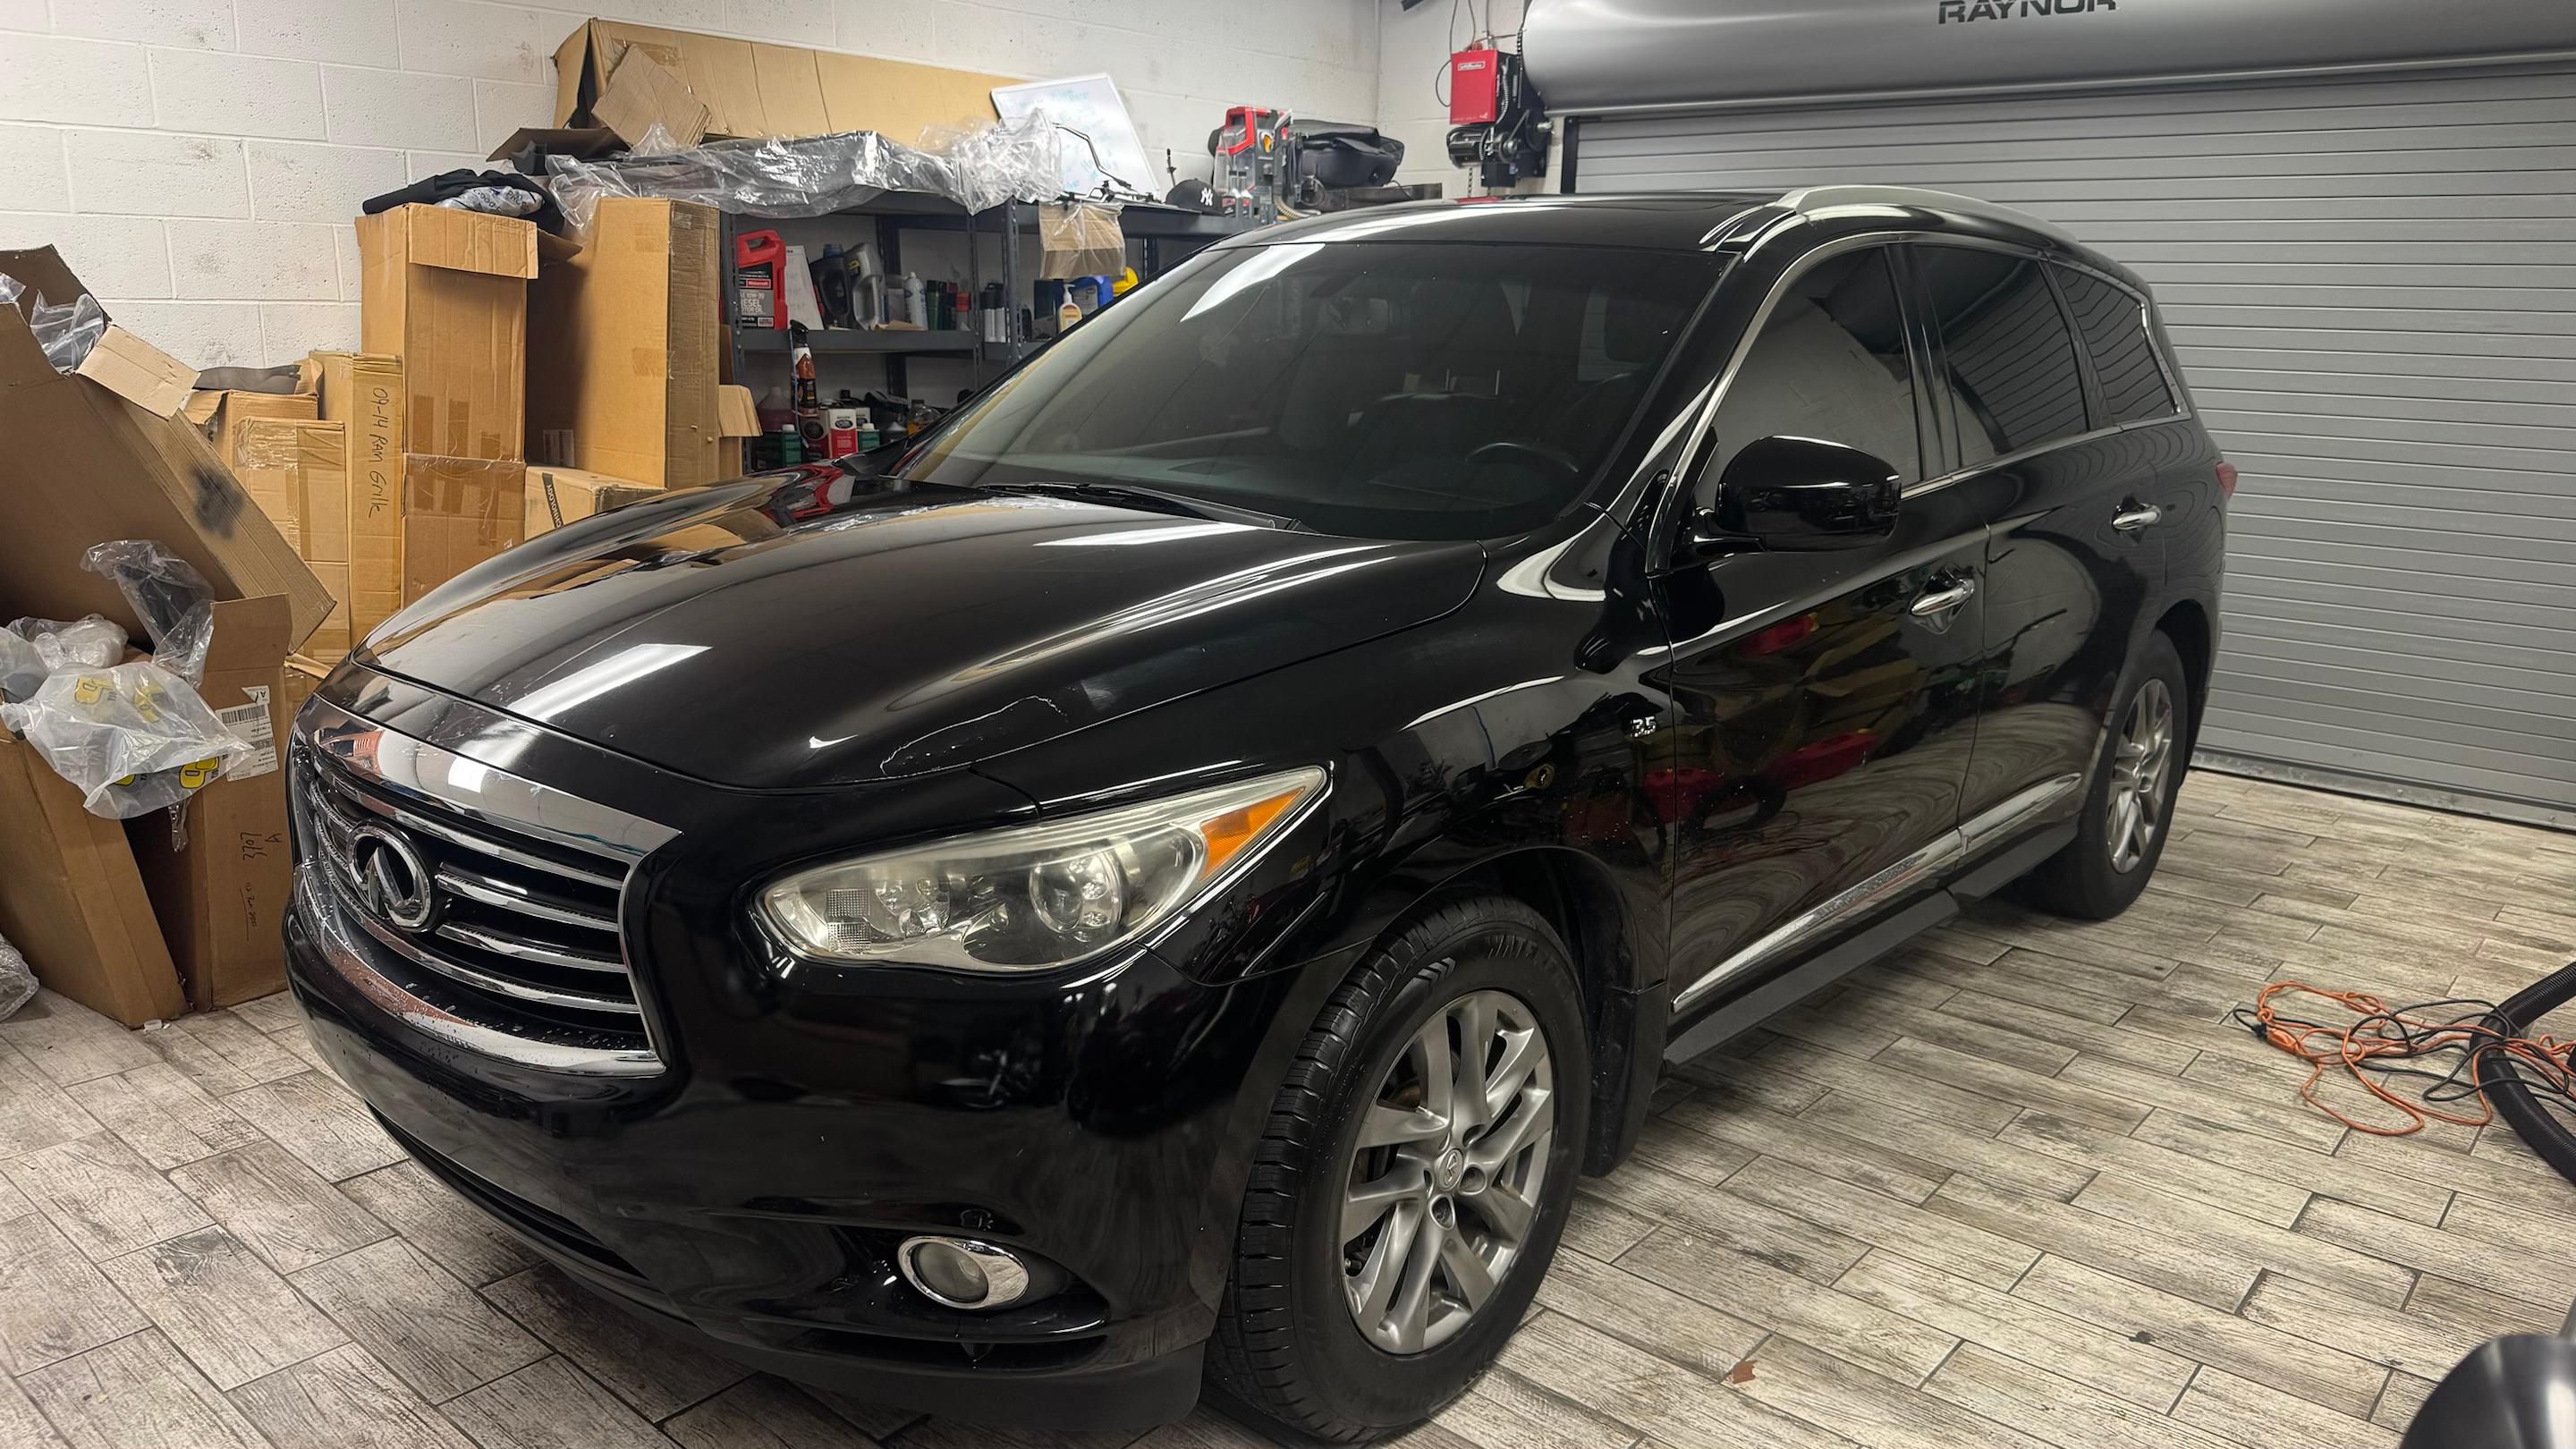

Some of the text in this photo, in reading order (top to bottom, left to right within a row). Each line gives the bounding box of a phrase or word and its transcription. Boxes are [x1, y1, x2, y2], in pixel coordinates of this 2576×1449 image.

[741, 299, 762, 307] IESEL
[371, 387, 389, 428] 09-14
[547, 484, 563, 528] CHNOLOGY
